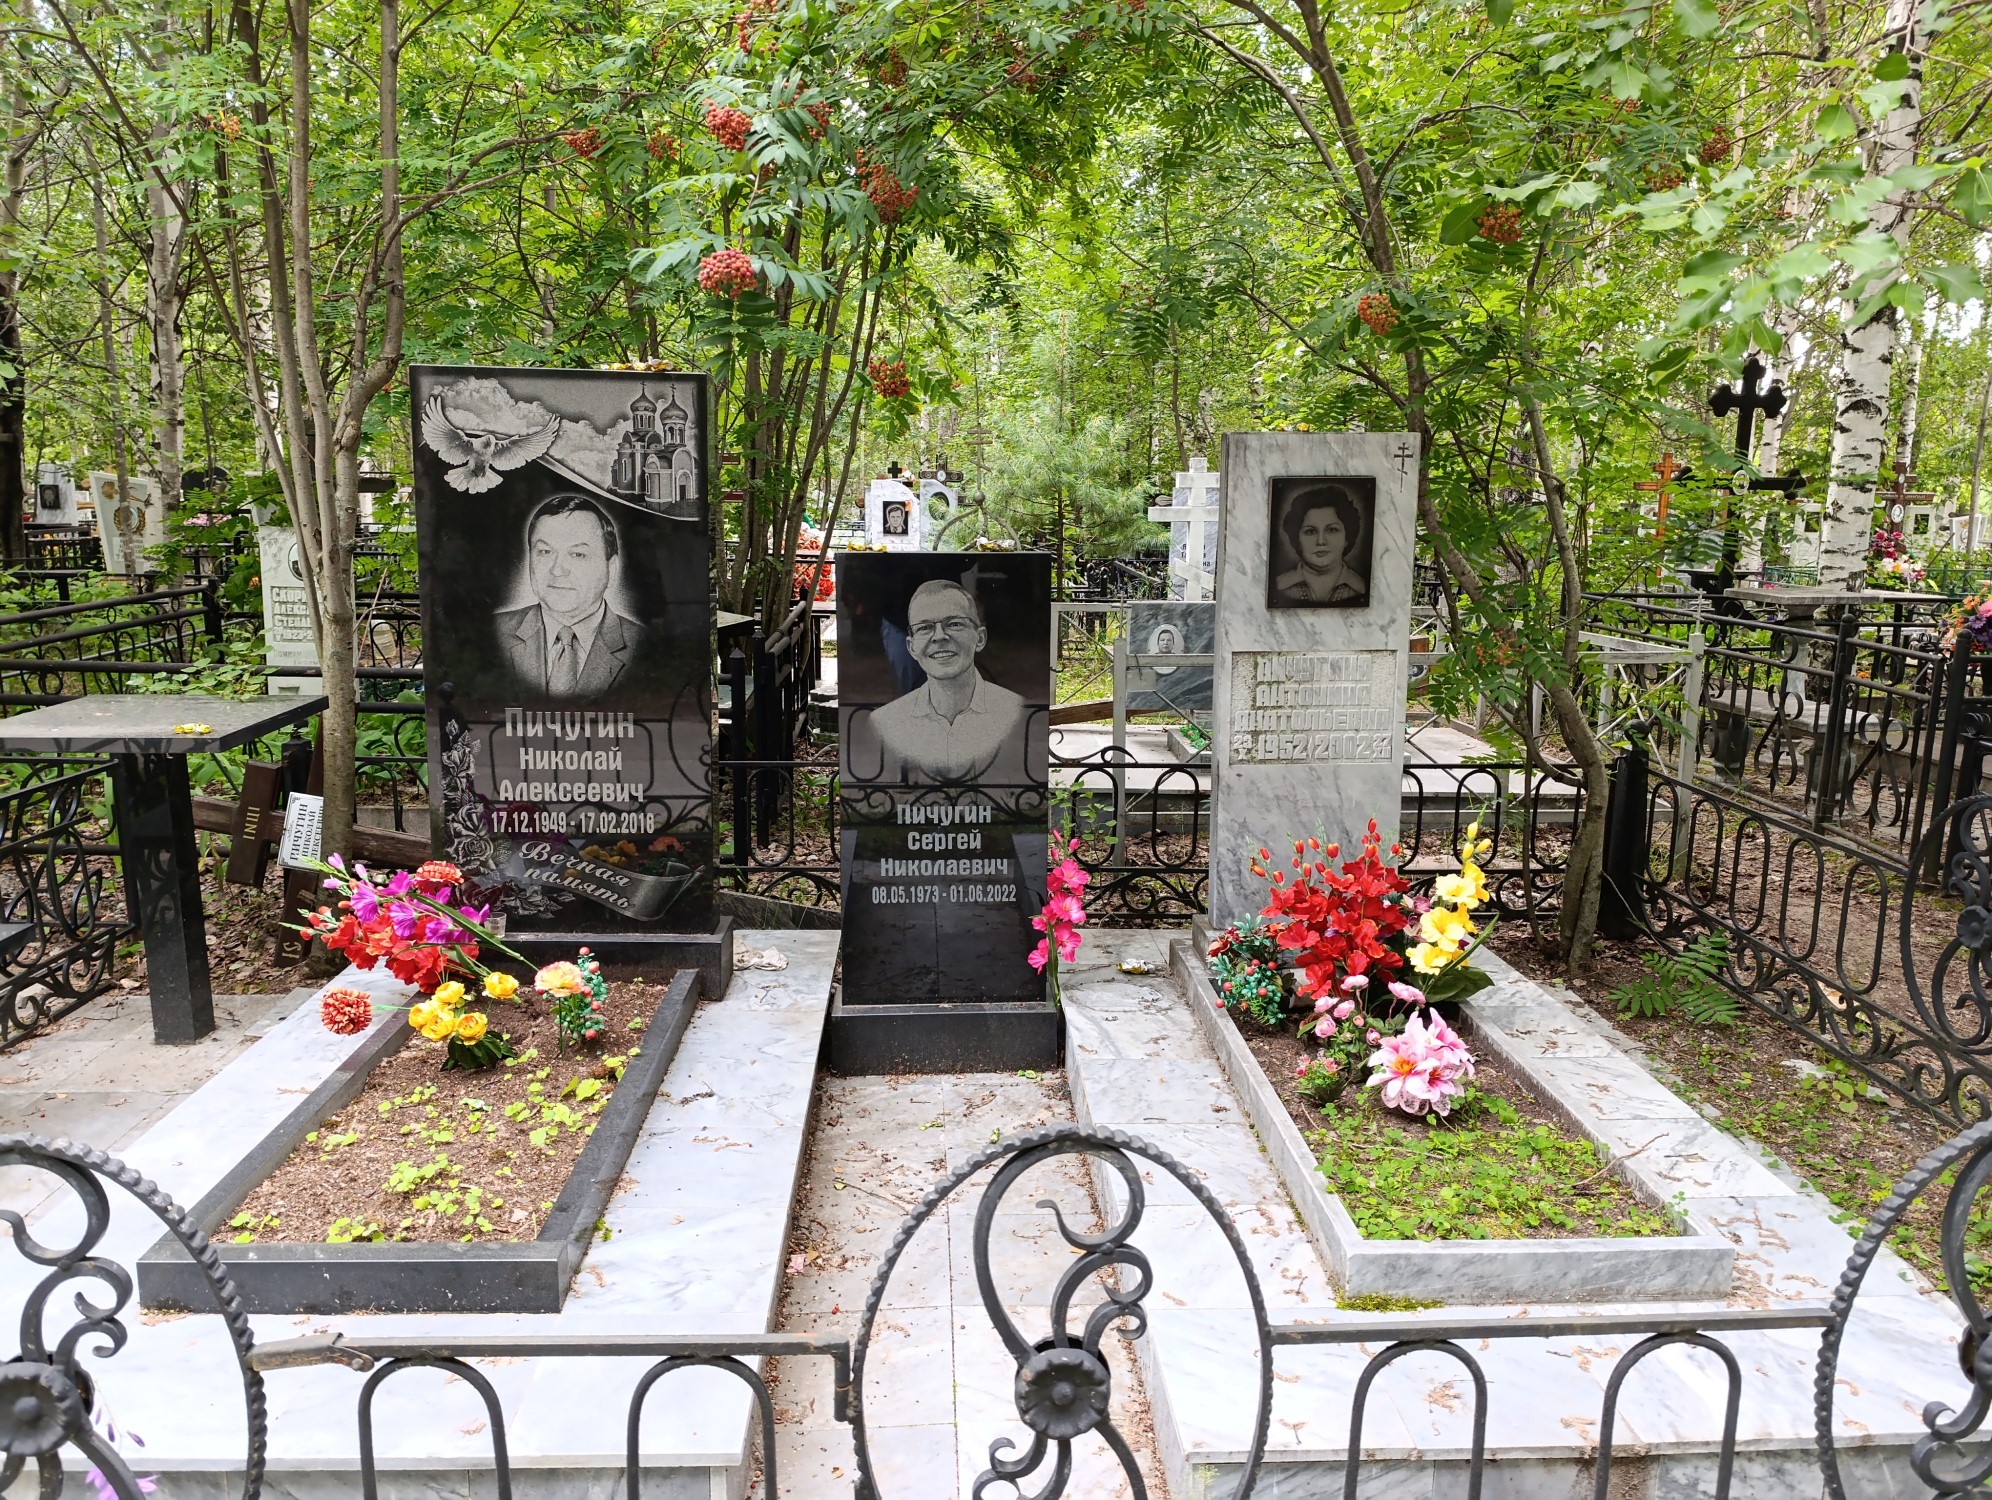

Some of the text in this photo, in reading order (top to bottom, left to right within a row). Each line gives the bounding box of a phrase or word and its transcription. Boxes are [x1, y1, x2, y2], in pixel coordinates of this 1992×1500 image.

[1257, 655, 1371, 681] ПИЧУГИНА
[1256, 684, 1371, 706] АНТОНИНА
[504, 707, 635, 741] Пичугин
[1234, 709, 1390, 731] АНАТОЛЬЕВНА
[519, 746, 622, 771] Николай
[1258, 734, 1307, 760] 1952
[1315, 734, 1371, 759] 2002
[499, 779, 644, 803] Алексеевич
[491, 811, 567, 834] 17.12.1949
[580, 812, 655, 835] 17.02.2018
[896, 804, 992, 826] Пичугин
[908, 829, 982, 852] Сергей
[518, 841, 633, 888] Вечная
[880, 858, 1008, 877] Николаевич
[523, 867, 635, 909] память
[872, 885, 939, 904] 08.05.1973
[949, 884, 1017, 903] 01.06.2022
